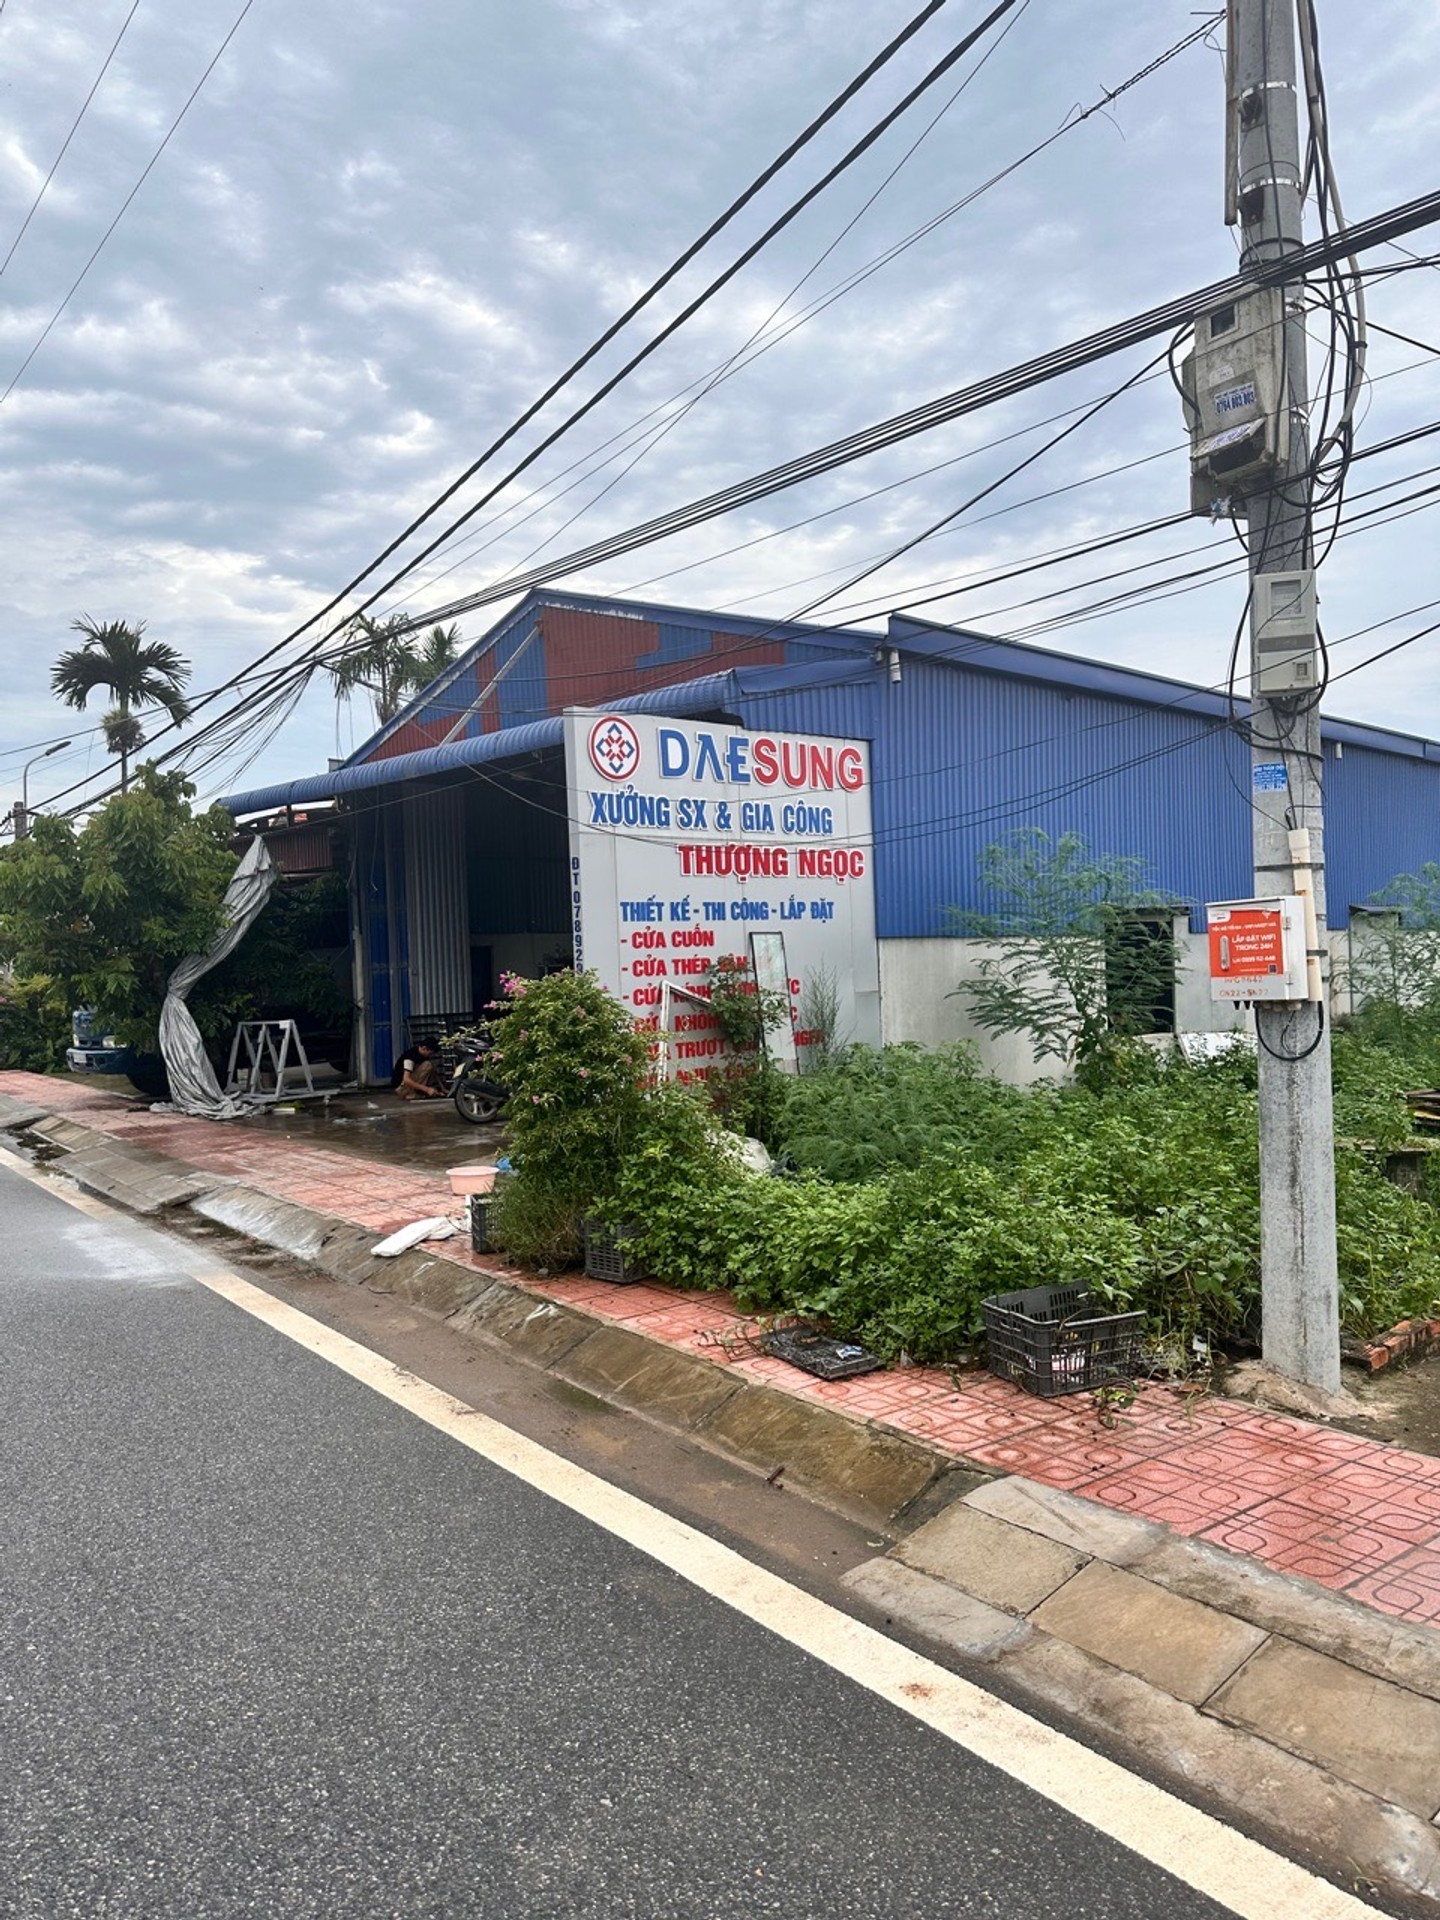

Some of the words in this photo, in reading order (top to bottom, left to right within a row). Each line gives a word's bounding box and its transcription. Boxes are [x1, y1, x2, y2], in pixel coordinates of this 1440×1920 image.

[658, 727, 865, 791] DAESUNG
[590, 785, 670, 827] XƯỞNG
[677, 798, 708, 829] SX
[716, 801, 732, 830] &
[742, 803, 774, 833] GIA
[783, 800, 833, 834] CÔNG
[678, 844, 788, 882] THƯỢNG
[799, 849, 865, 883] NGỌC
[620, 895, 664, 922] THIẾT
[670, 895, 691, 922] KẾ
[703, 901, 726, 921] THI
[731, 898, 769, 921] CÔNG
[780, 895, 806, 920] LẮP
[810, 898, 834, 923] ĐẶT
[632, 926, 667, 949] CỬA
[672, 924, 714, 947] CUỐN
[632, 954, 667, 977] CỬA
[672, 953, 711, 976] THÉP
